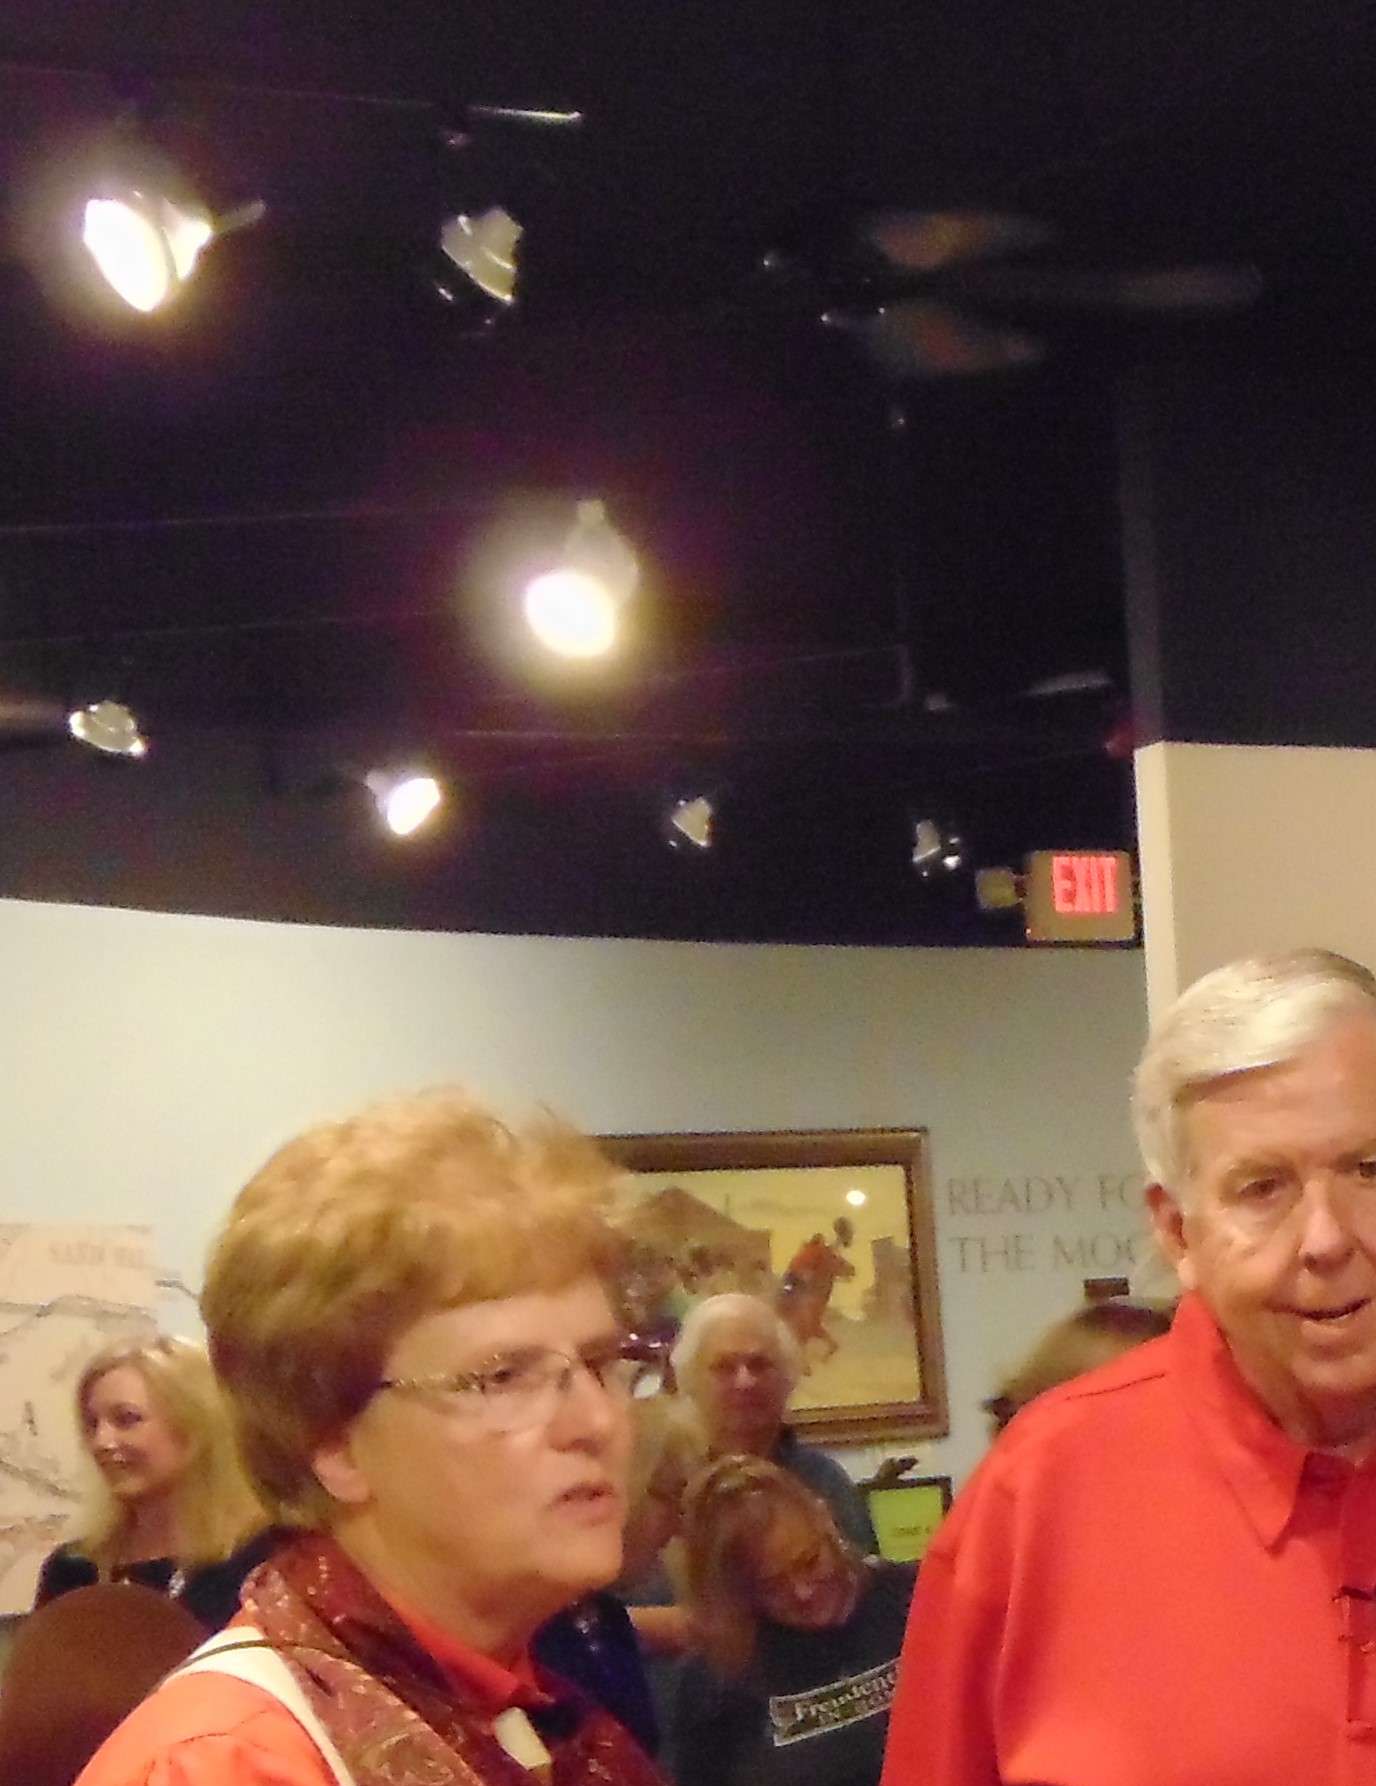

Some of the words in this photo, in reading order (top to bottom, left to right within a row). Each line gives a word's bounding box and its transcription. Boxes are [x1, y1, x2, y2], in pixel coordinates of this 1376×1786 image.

[1053, 856, 1116, 912] EXIT
[947, 1175, 1078, 1215] READY
[947, 1232, 1035, 1273] THE
